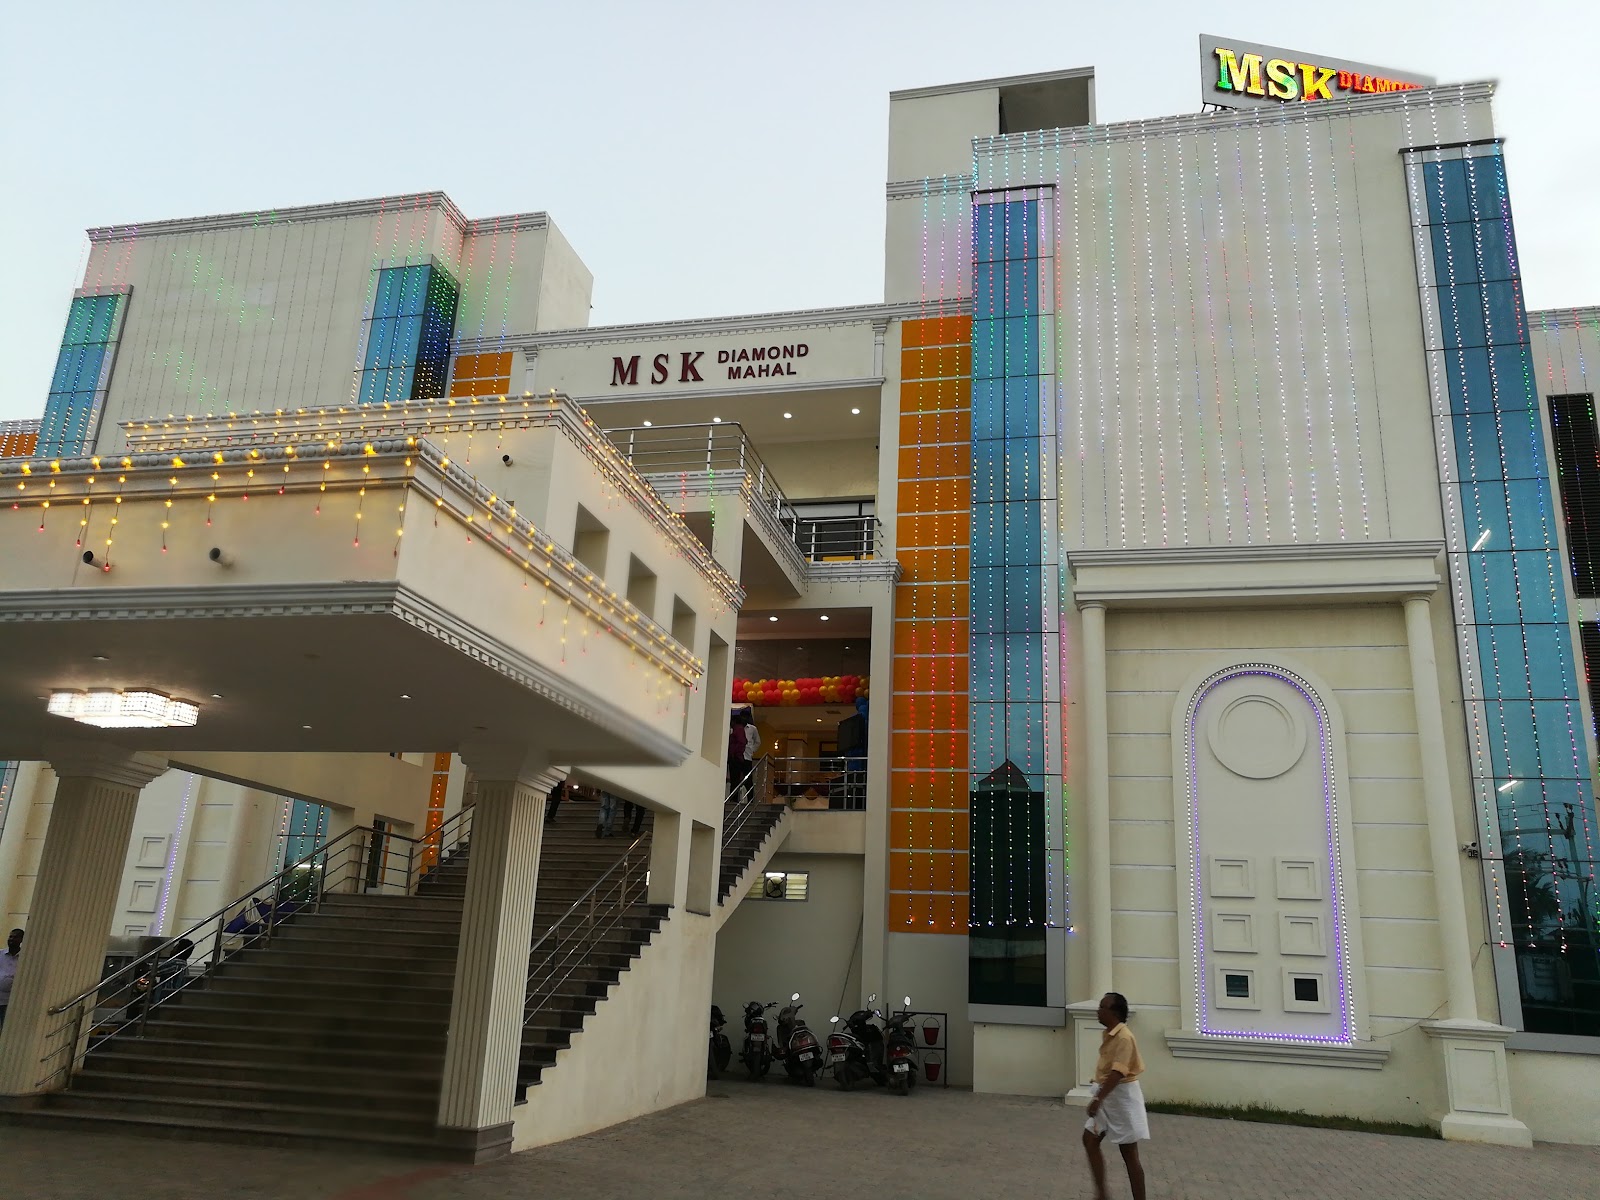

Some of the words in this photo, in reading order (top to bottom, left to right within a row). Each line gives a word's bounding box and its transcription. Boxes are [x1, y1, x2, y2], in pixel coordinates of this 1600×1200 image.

[1215, 47, 1336, 101] MSK
[610, 351, 704, 386] MSK
[718, 343, 809, 364] DIAMOND
[728, 362, 796, 380] MAHAL
